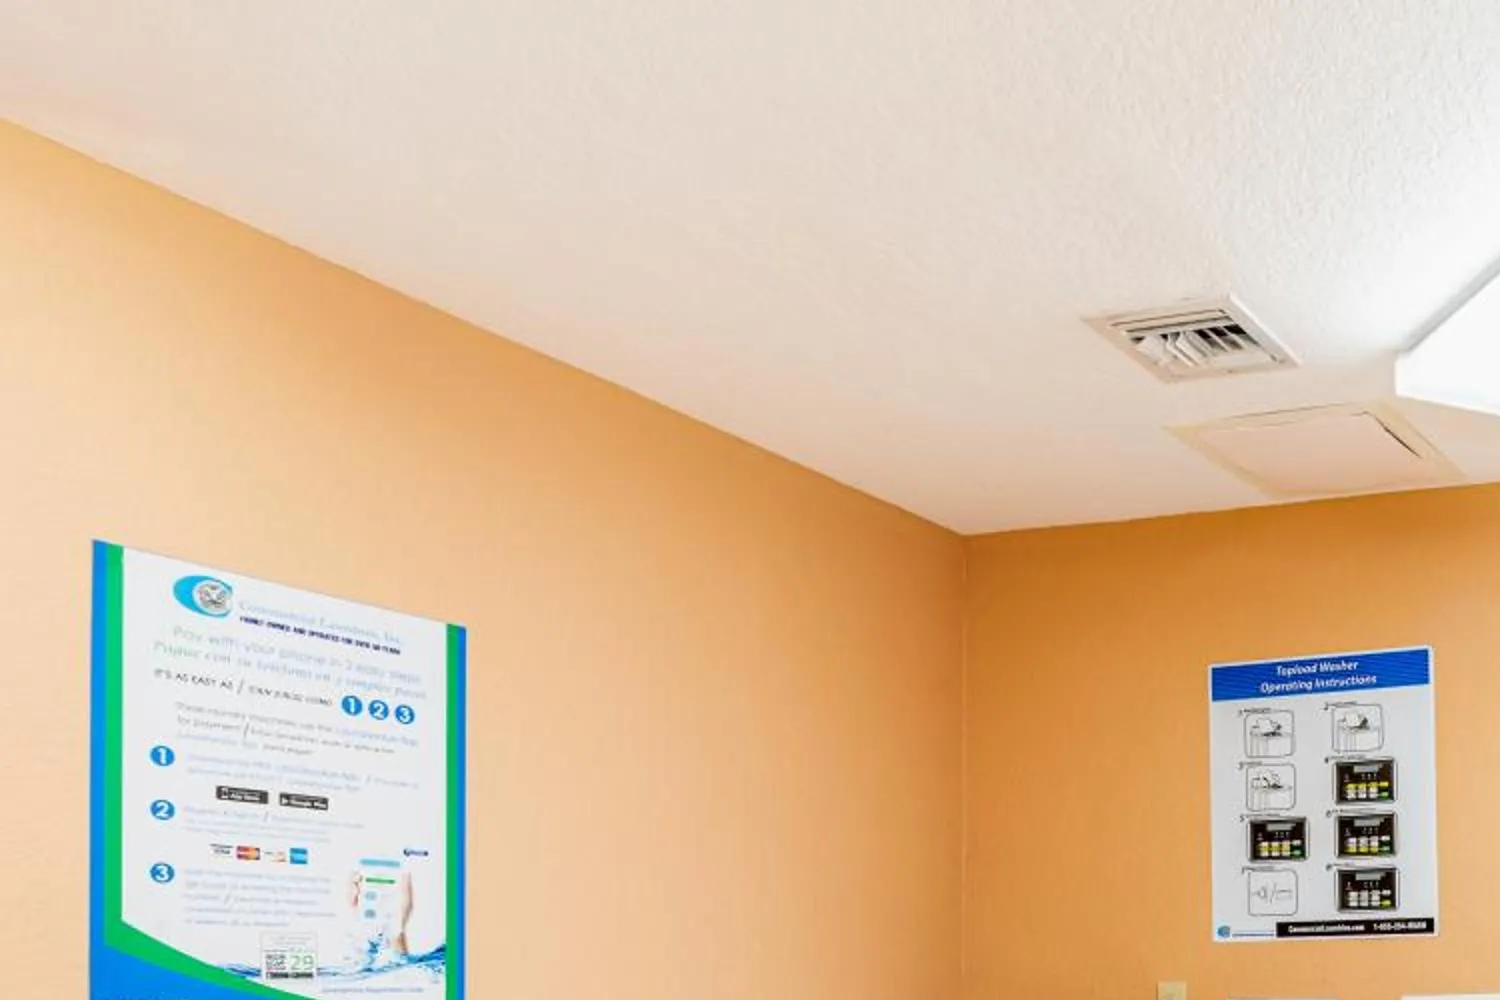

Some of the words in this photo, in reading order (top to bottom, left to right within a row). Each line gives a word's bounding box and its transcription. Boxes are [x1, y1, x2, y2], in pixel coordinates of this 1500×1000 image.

[1276, 663, 1317, 678] Topload
[1318, 660, 1359, 674] Washer
[1260, 681, 1313, 696] Operating
[1314, 675, 1378, 689] Instructions
[290, 955, 315, 971] 29
